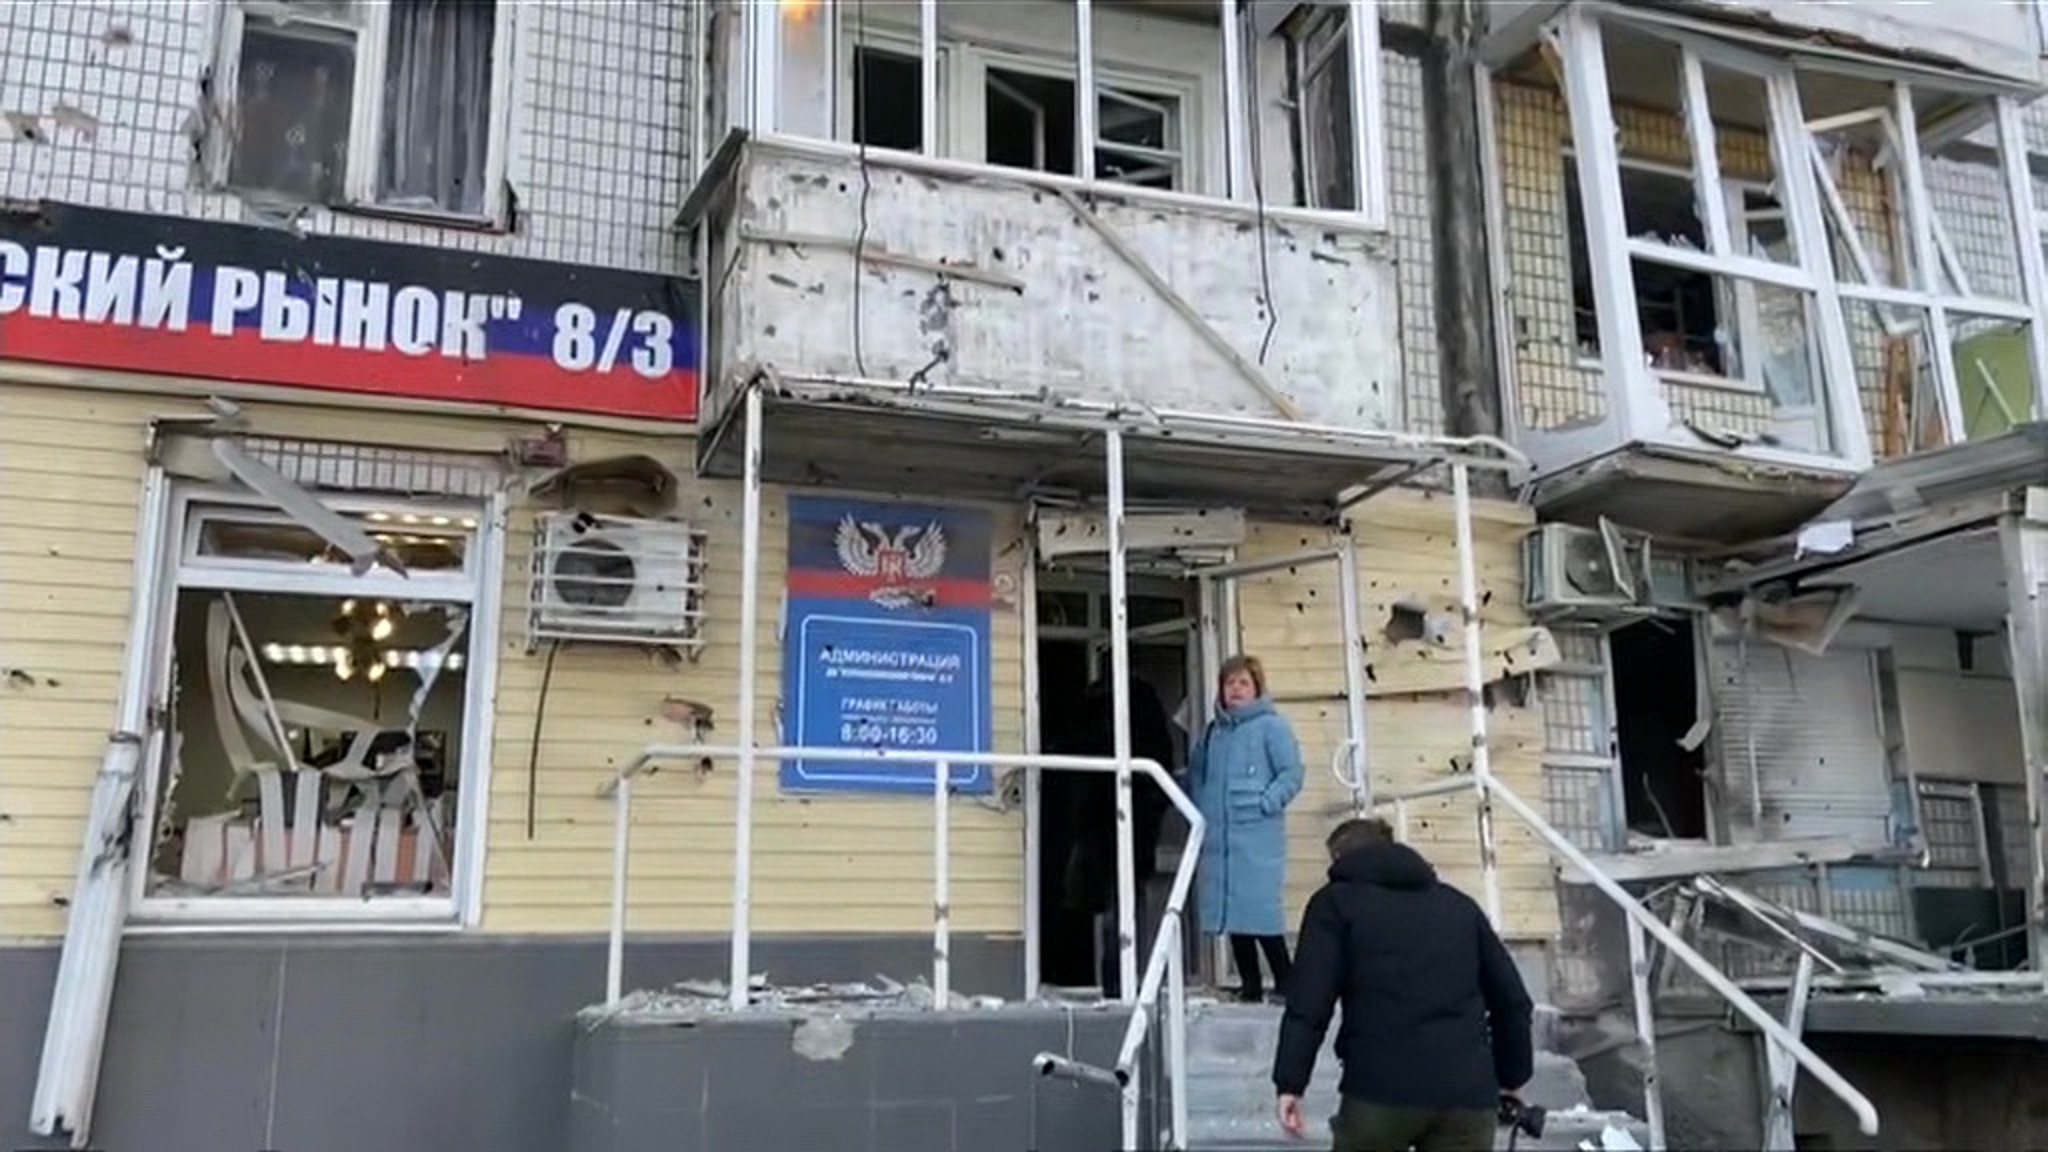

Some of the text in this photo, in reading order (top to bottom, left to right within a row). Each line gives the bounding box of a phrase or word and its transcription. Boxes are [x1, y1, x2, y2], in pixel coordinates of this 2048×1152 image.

[0, 240, 675, 379] СКИЙ РЫНОК" 8/3
[820, 648, 960, 670] АДМИНИСТРАЦИЯ
[840, 698, 887, 712] ГРАФИК
